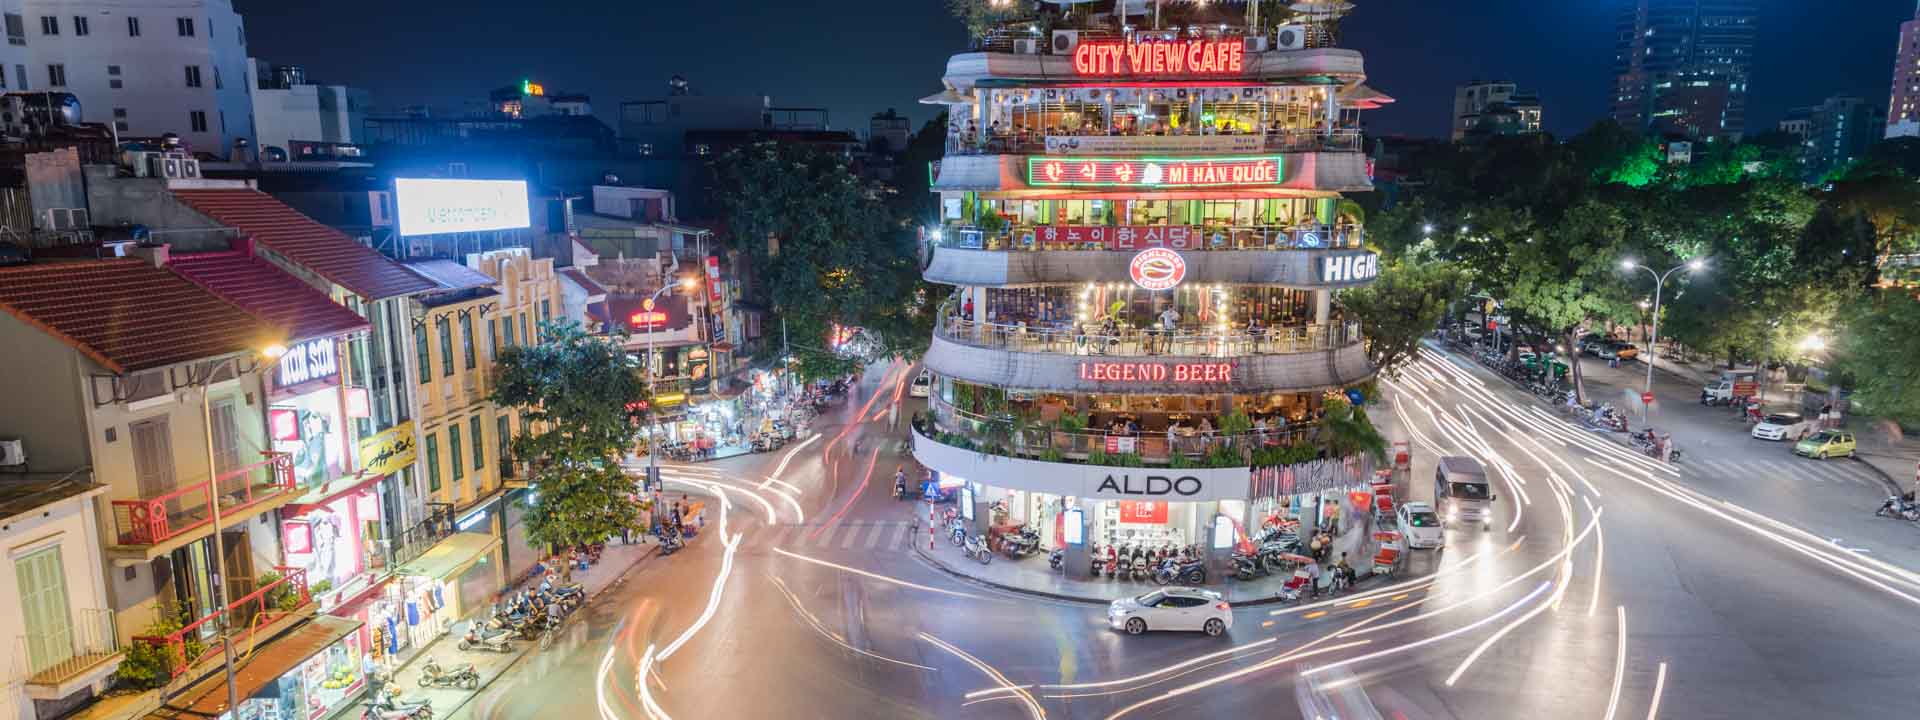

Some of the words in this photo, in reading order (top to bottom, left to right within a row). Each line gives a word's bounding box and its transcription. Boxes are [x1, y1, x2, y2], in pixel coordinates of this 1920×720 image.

[1075, 43, 1125, 74] CITY
[1127, 42, 1186, 73] VIEW
[1187, 41, 1242, 72] CAFE
[1169, 162, 1187, 182] MÌ
[1193, 161, 1227, 182] HÀN
[1080, 363, 1166, 381] LEGEND
[1175, 364, 1232, 382] BEER
[1097, 474, 1202, 496] ALDO
